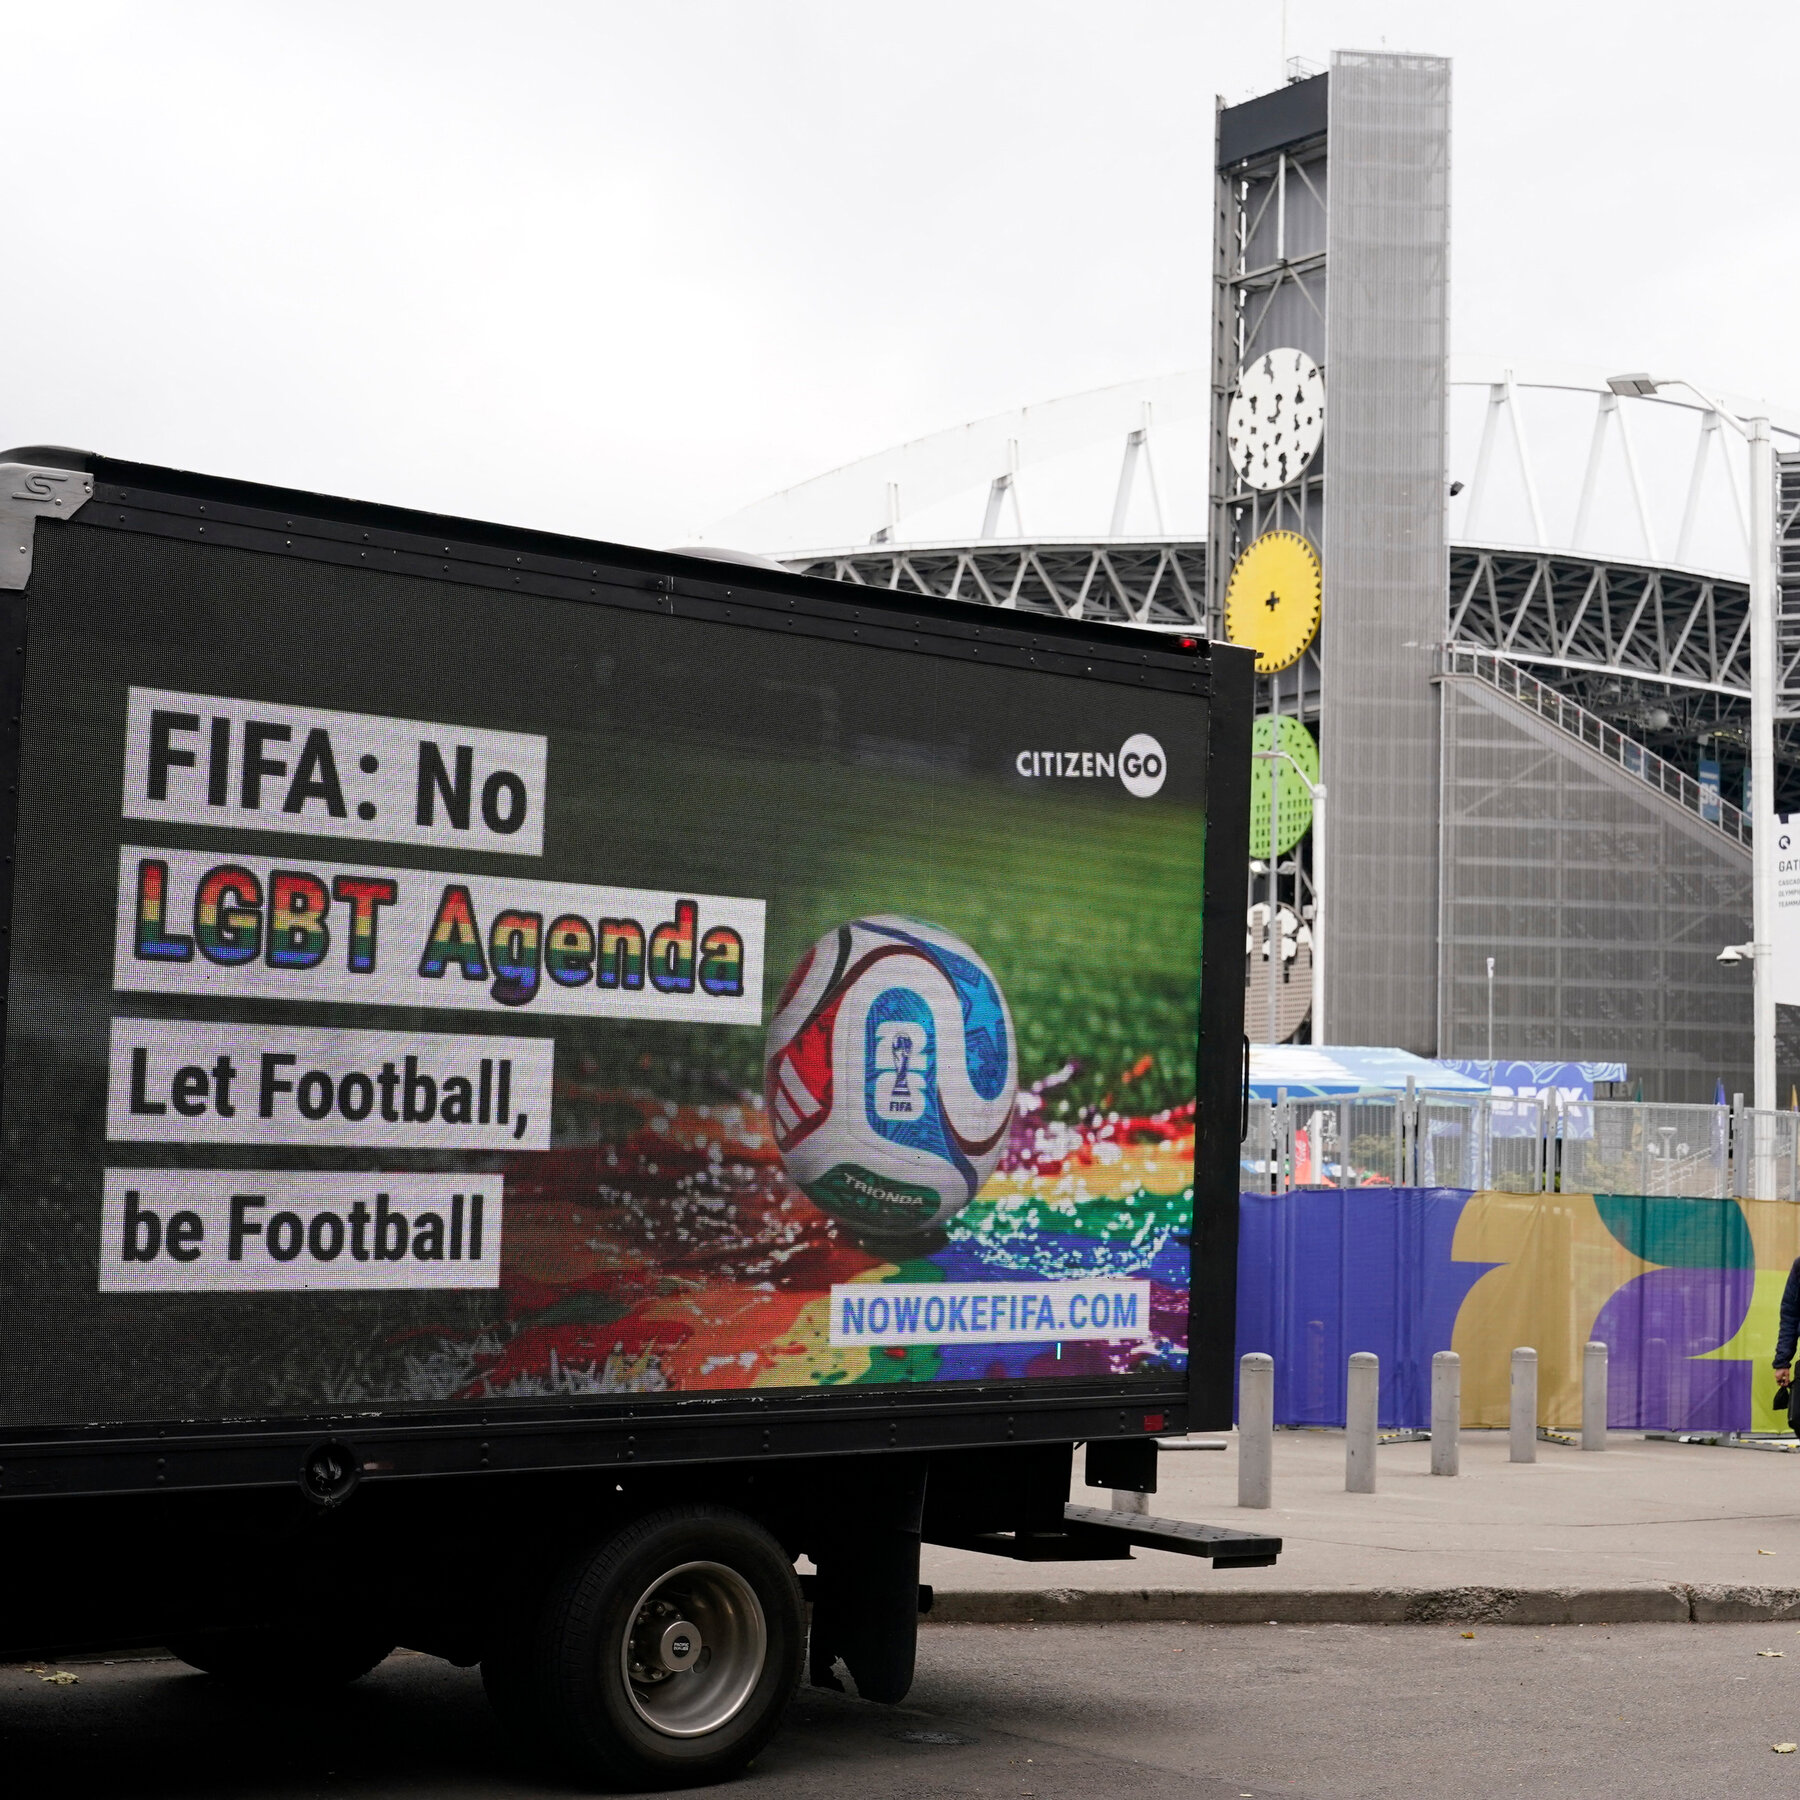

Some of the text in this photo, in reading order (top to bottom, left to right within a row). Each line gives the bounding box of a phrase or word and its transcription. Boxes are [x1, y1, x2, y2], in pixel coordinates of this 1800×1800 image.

[147, 708, 528, 835] FIFA: No
[1778, 859, 1800, 872] GAT
[134, 858, 744, 1007] LGBT Agenda
[130, 1047, 528, 1140] Let Football,
[889, 1101, 913, 1113] FIFA
[844, 1172, 924, 1206] TRIONDA
[122, 1190, 484, 1262] be Football
[842, 1293, 1137, 1335] NOWOKEFIFA.COM
